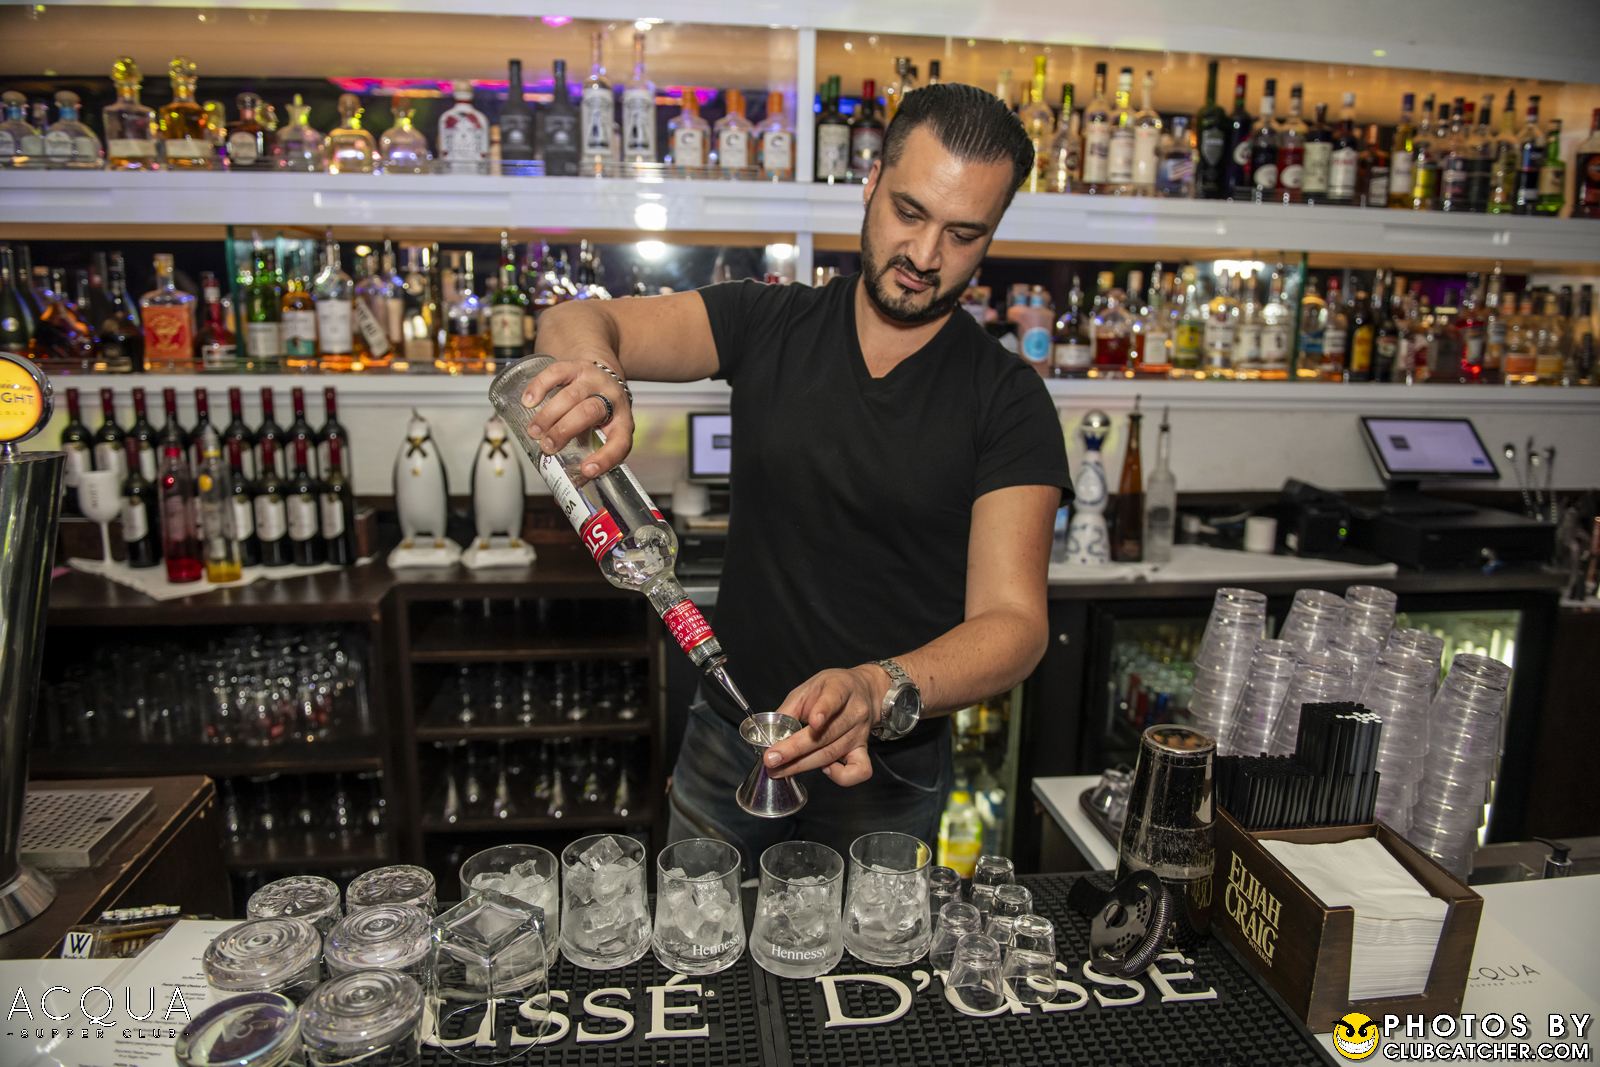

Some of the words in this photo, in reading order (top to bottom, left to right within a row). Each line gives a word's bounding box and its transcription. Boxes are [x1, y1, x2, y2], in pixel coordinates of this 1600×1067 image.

[683, 625, 712, 643] PREMIUM
[1228, 850, 1282, 930] ELIJAH
[1225, 882, 1279, 959] CRAIG
[771, 943, 829, 961] Hennessy
